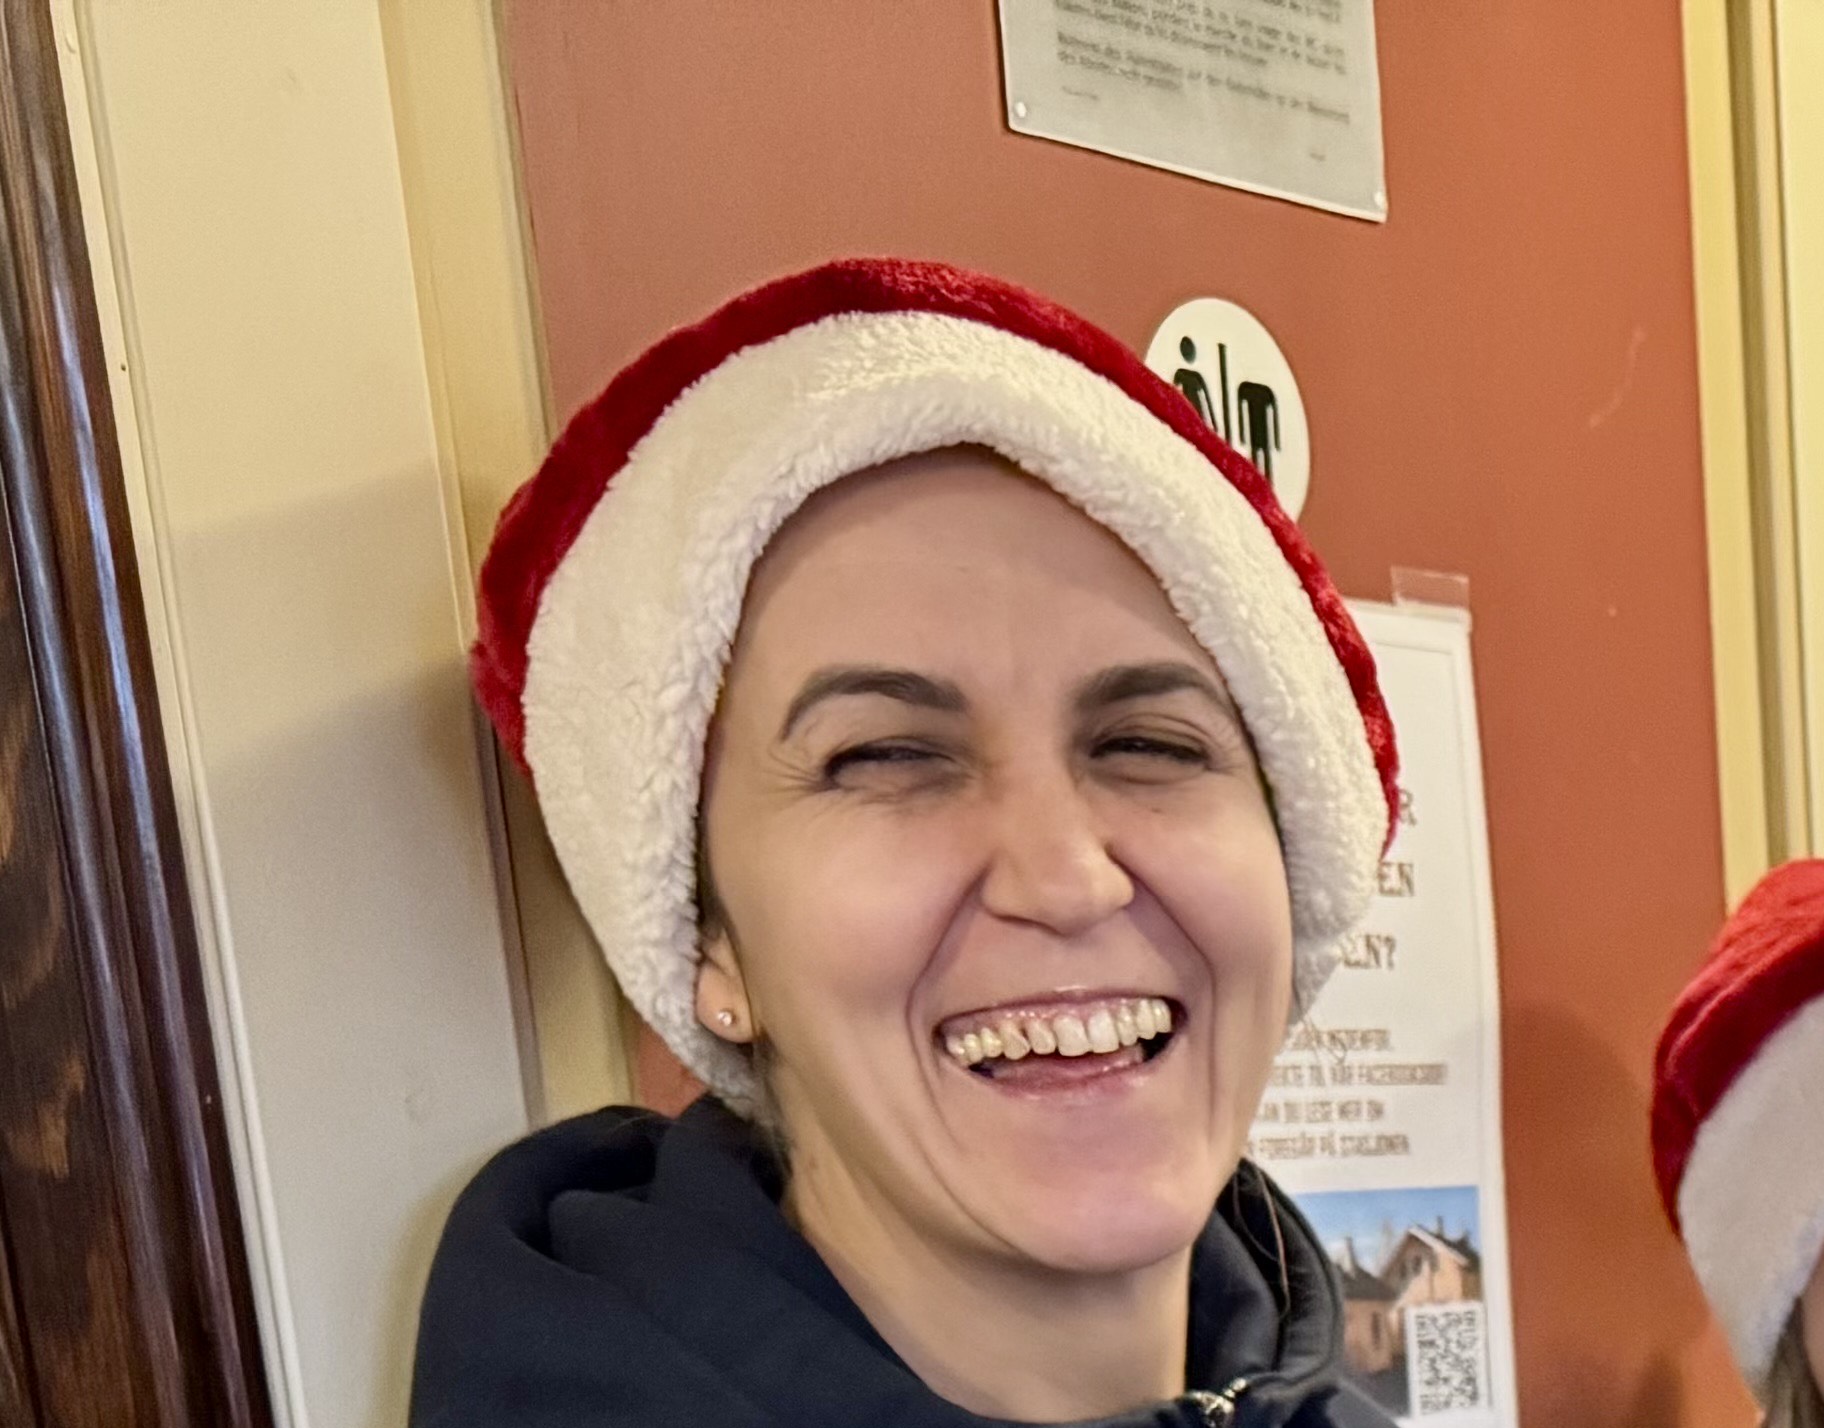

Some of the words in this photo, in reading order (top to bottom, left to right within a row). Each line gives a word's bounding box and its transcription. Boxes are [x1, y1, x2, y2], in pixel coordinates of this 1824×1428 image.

[1398, 789, 1417, 826] R
[1378, 861, 1415, 897] EN
[1344, 933, 1396, 970] EN?
